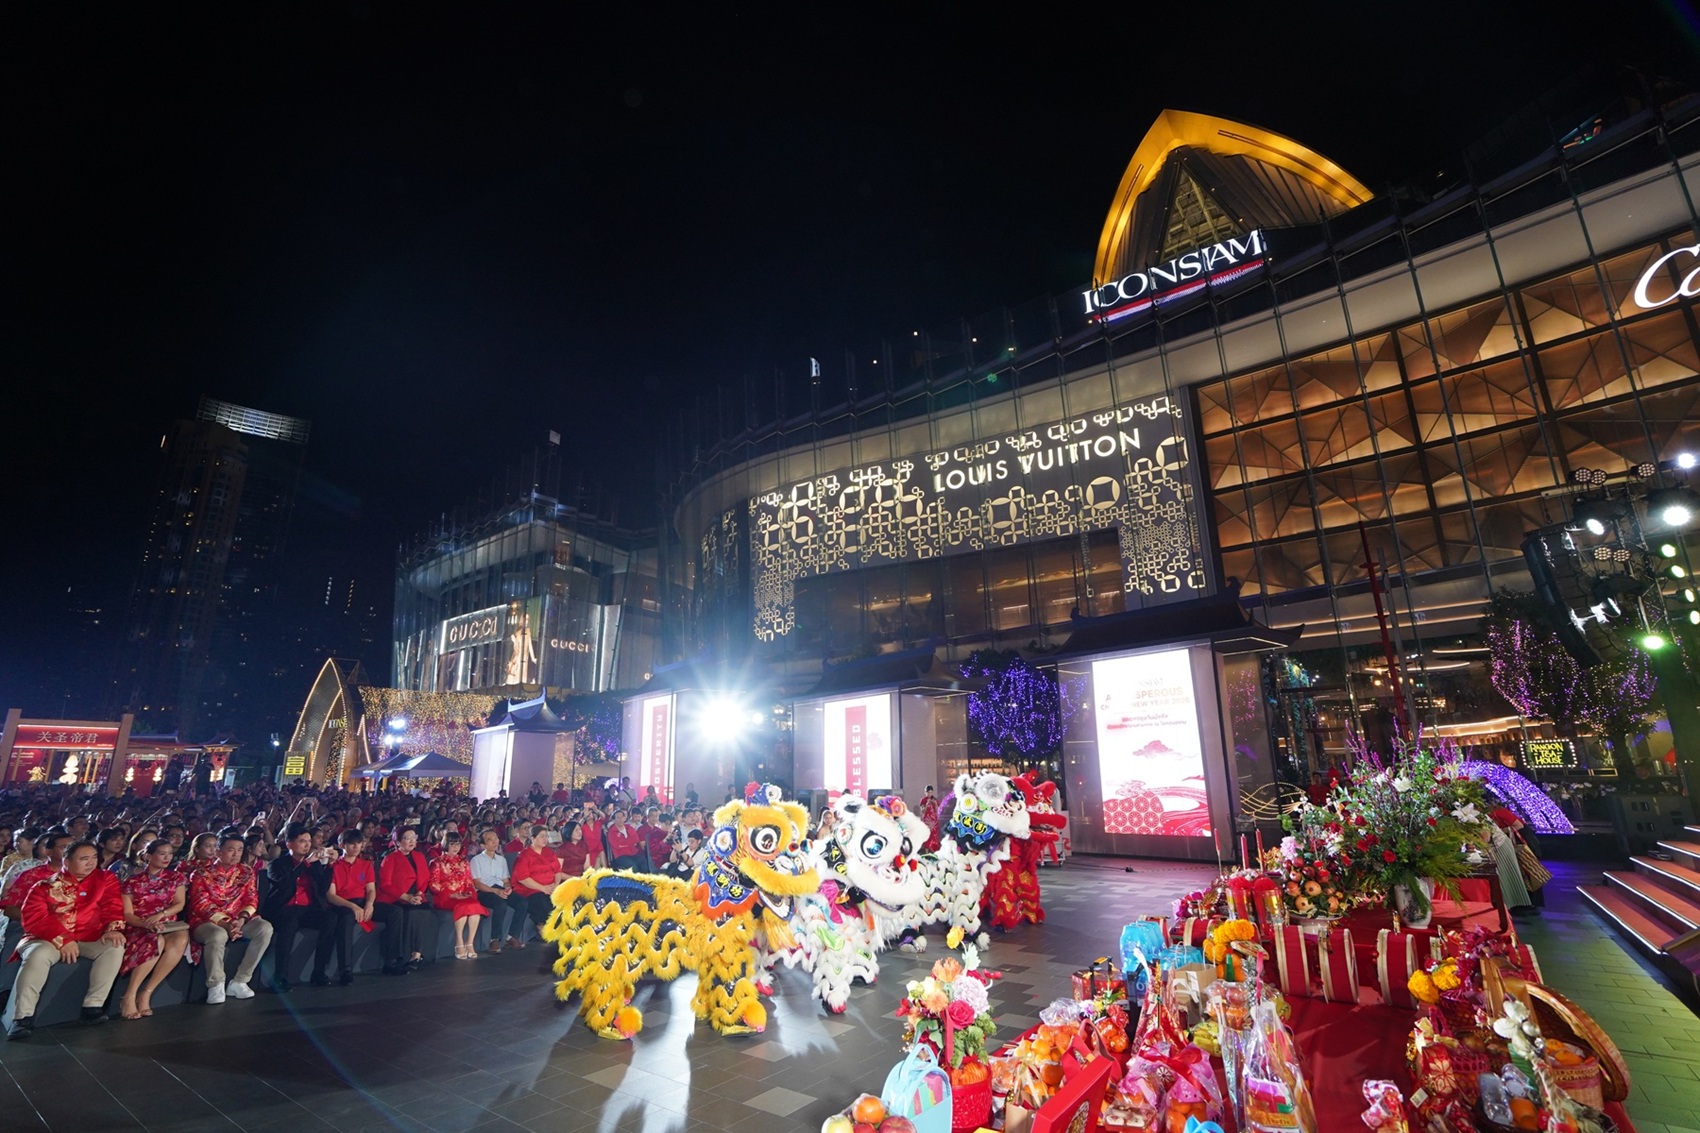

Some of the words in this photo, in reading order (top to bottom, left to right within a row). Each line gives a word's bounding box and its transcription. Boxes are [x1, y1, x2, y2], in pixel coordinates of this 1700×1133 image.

[1082, 229, 1263, 314] ICONSIAM
[934, 460, 1008, 492] LOUIS
[1018, 428, 1141, 474] VUITTON
[551, 639, 589, 653] GUCCI
[36, 731, 98, 744] 关圣帝君
[654, 714, 663, 794] ROSPERITY
[852, 724, 861, 797] BLESSED
